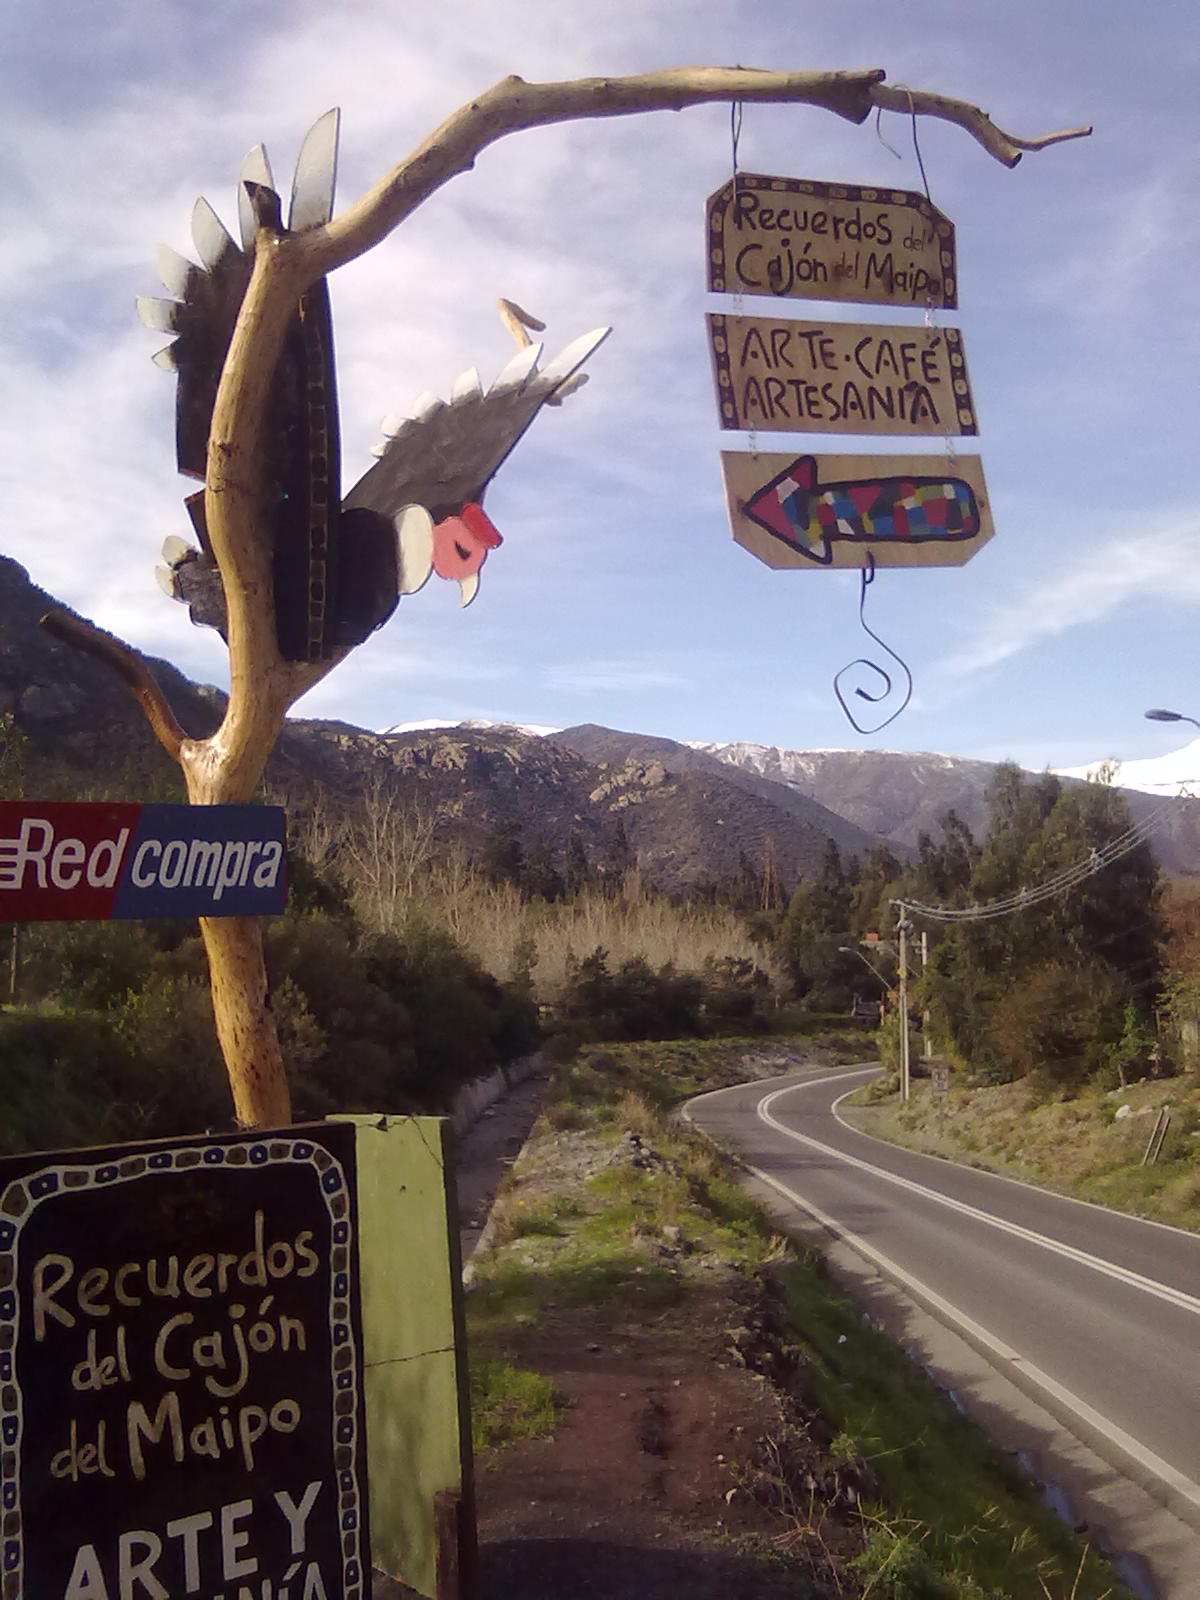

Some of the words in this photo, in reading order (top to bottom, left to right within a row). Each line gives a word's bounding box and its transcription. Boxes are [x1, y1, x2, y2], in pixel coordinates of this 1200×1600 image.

[734, 191, 893, 246] Recuerdos
[903, 226, 926, 251] del
[735, 238, 828, 296] Cajón
[832, 252, 860, 281] del
[864, 252, 941, 301] Maipo
[20, 818, 131, 890] Red
[131, 838, 283, 901] compra
[32, 1209, 320, 1342] Recuerdos
[72, 1324, 132, 1391] del
[154, 1295, 307, 1397] Cajón
[50, 1418, 116, 1482] del
[126, 1391, 301, 1481] Maipo
[65, 1499, 259, 1600] ARTE
[274, 1481, 323, 1555] Y
